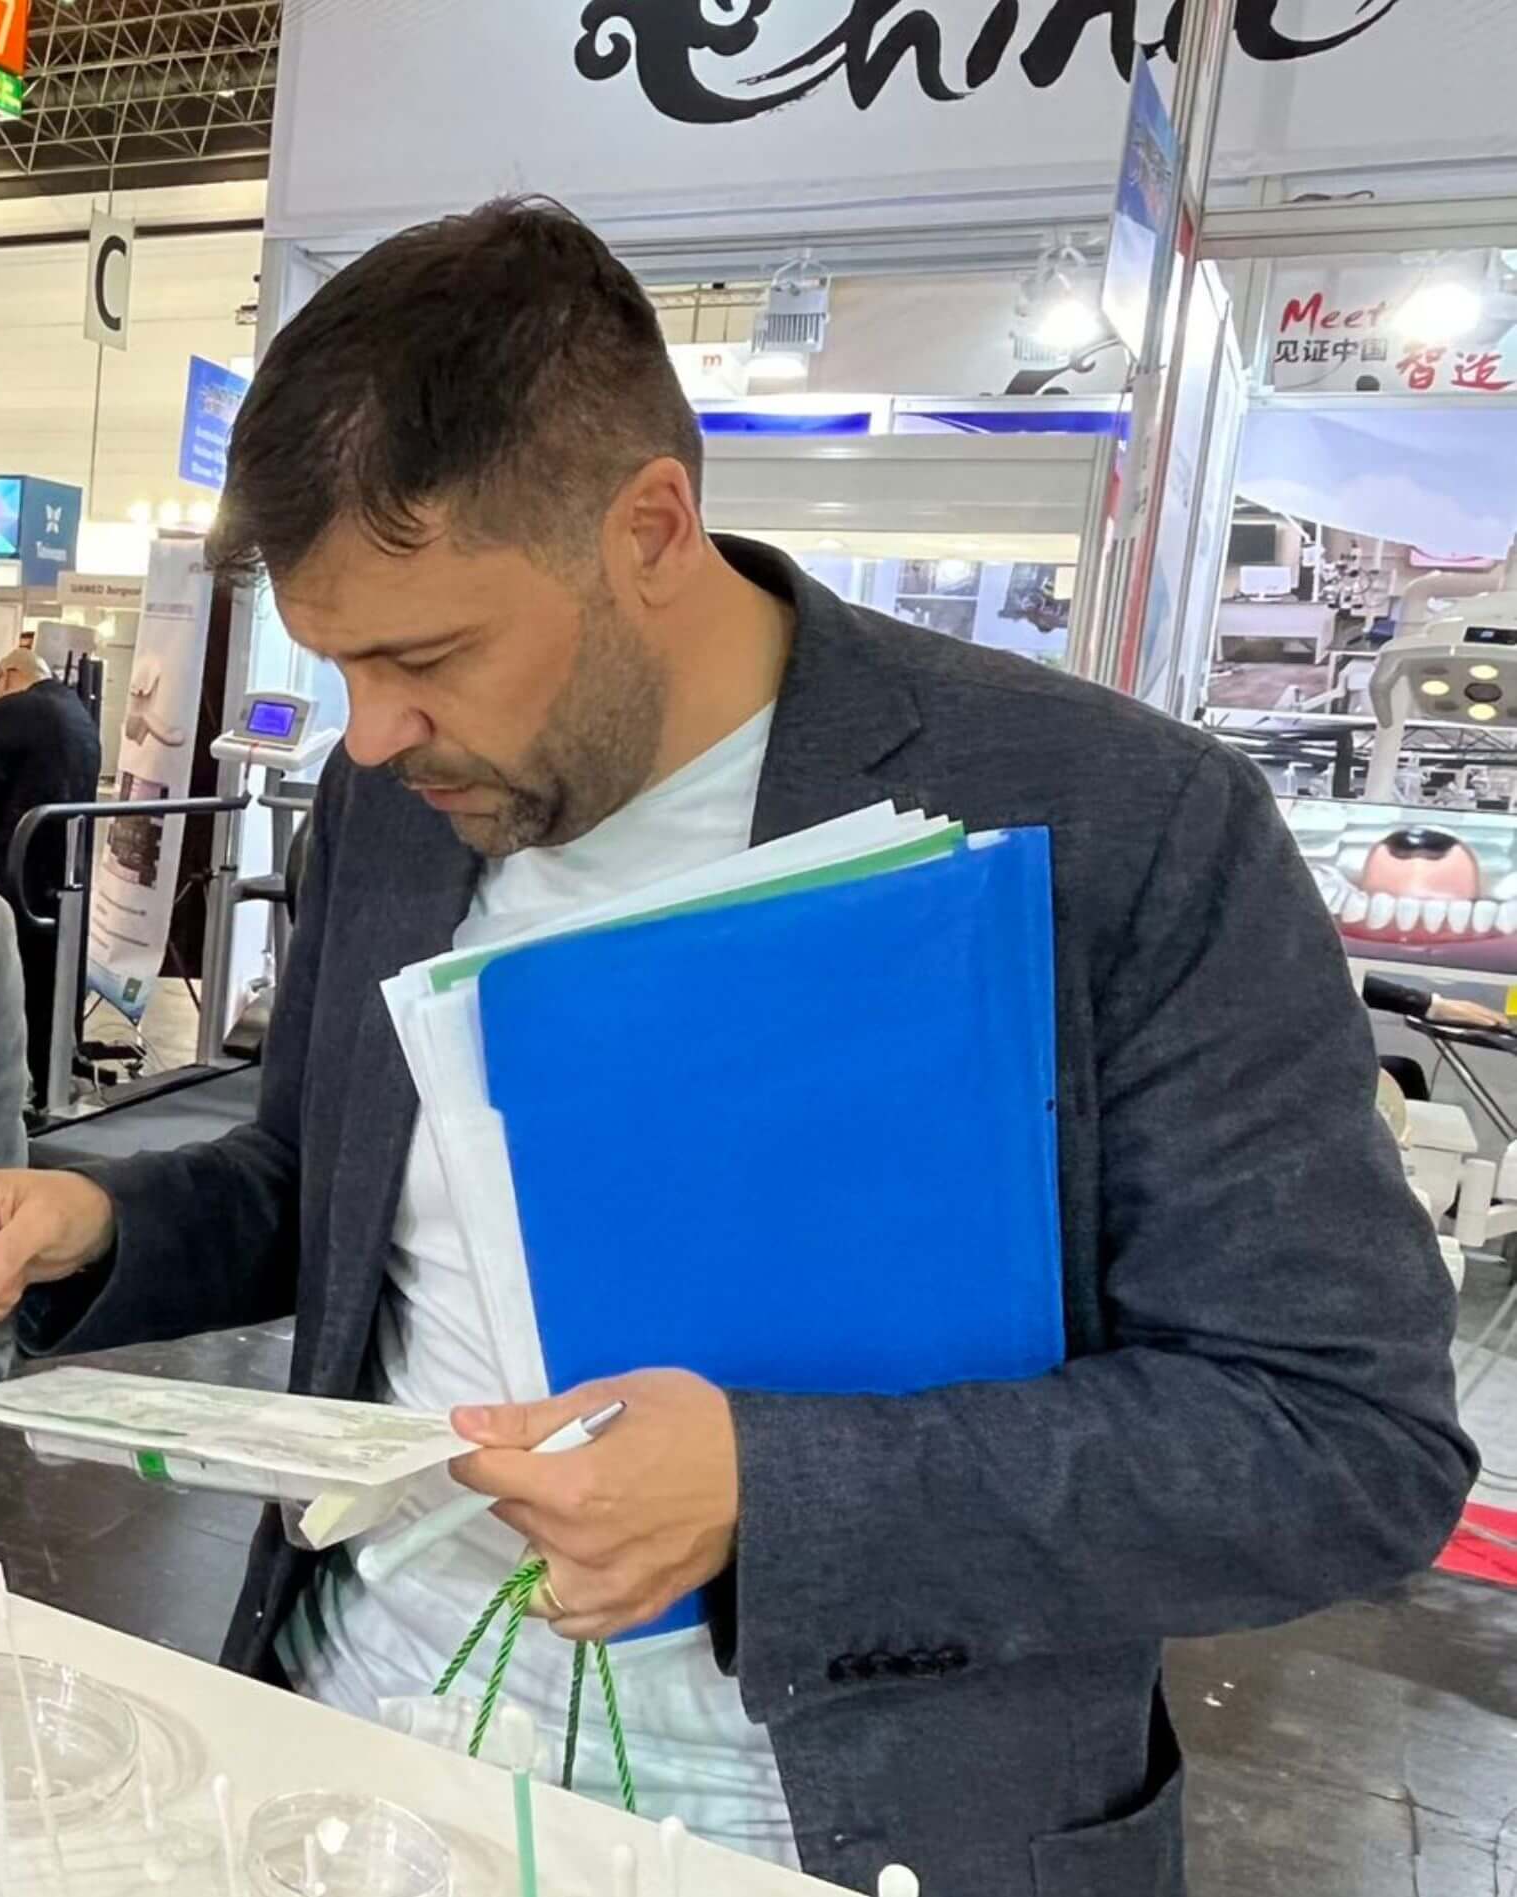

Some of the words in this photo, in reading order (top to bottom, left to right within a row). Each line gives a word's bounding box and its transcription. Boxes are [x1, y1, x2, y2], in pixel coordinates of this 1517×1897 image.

[94, 234, 127, 332] C
[1274, 338, 1388, 363] 见证中国
